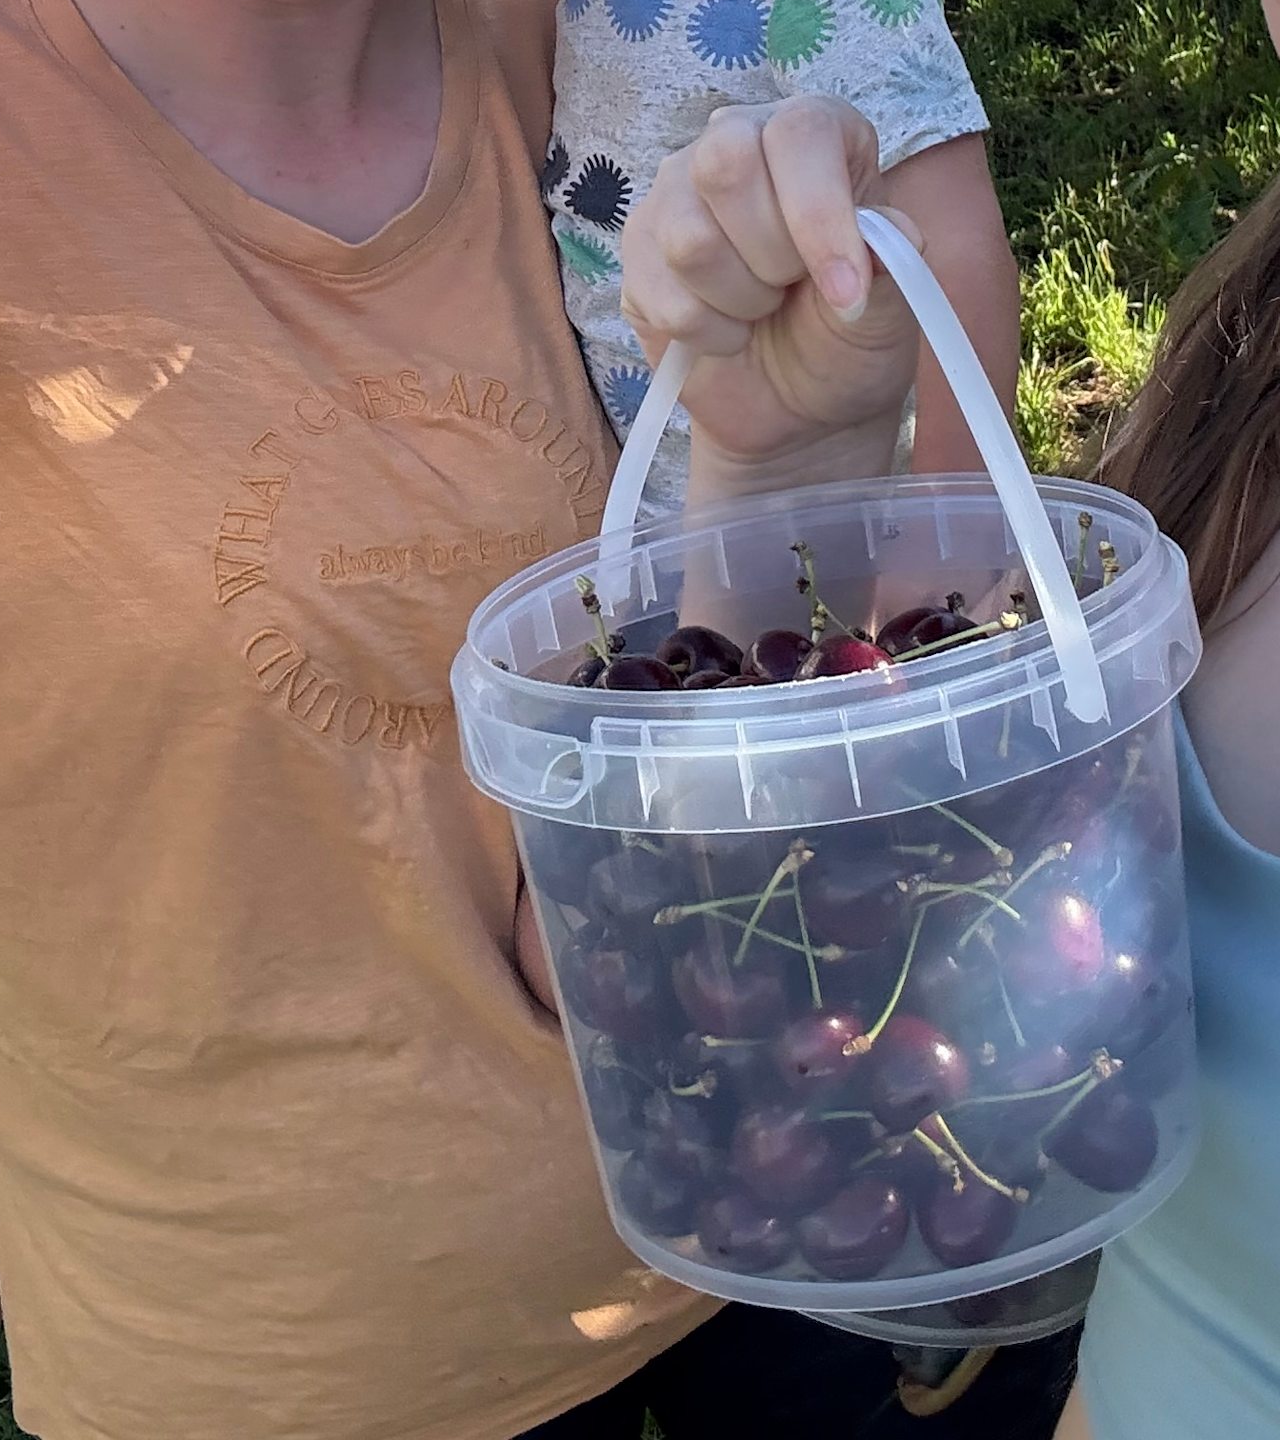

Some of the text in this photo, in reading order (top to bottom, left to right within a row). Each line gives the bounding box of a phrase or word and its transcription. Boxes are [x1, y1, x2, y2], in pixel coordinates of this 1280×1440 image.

[213, 427, 300, 608] WHAT
[319, 521, 547, 582] always be kind
[243, 627, 445, 750] AROUND
